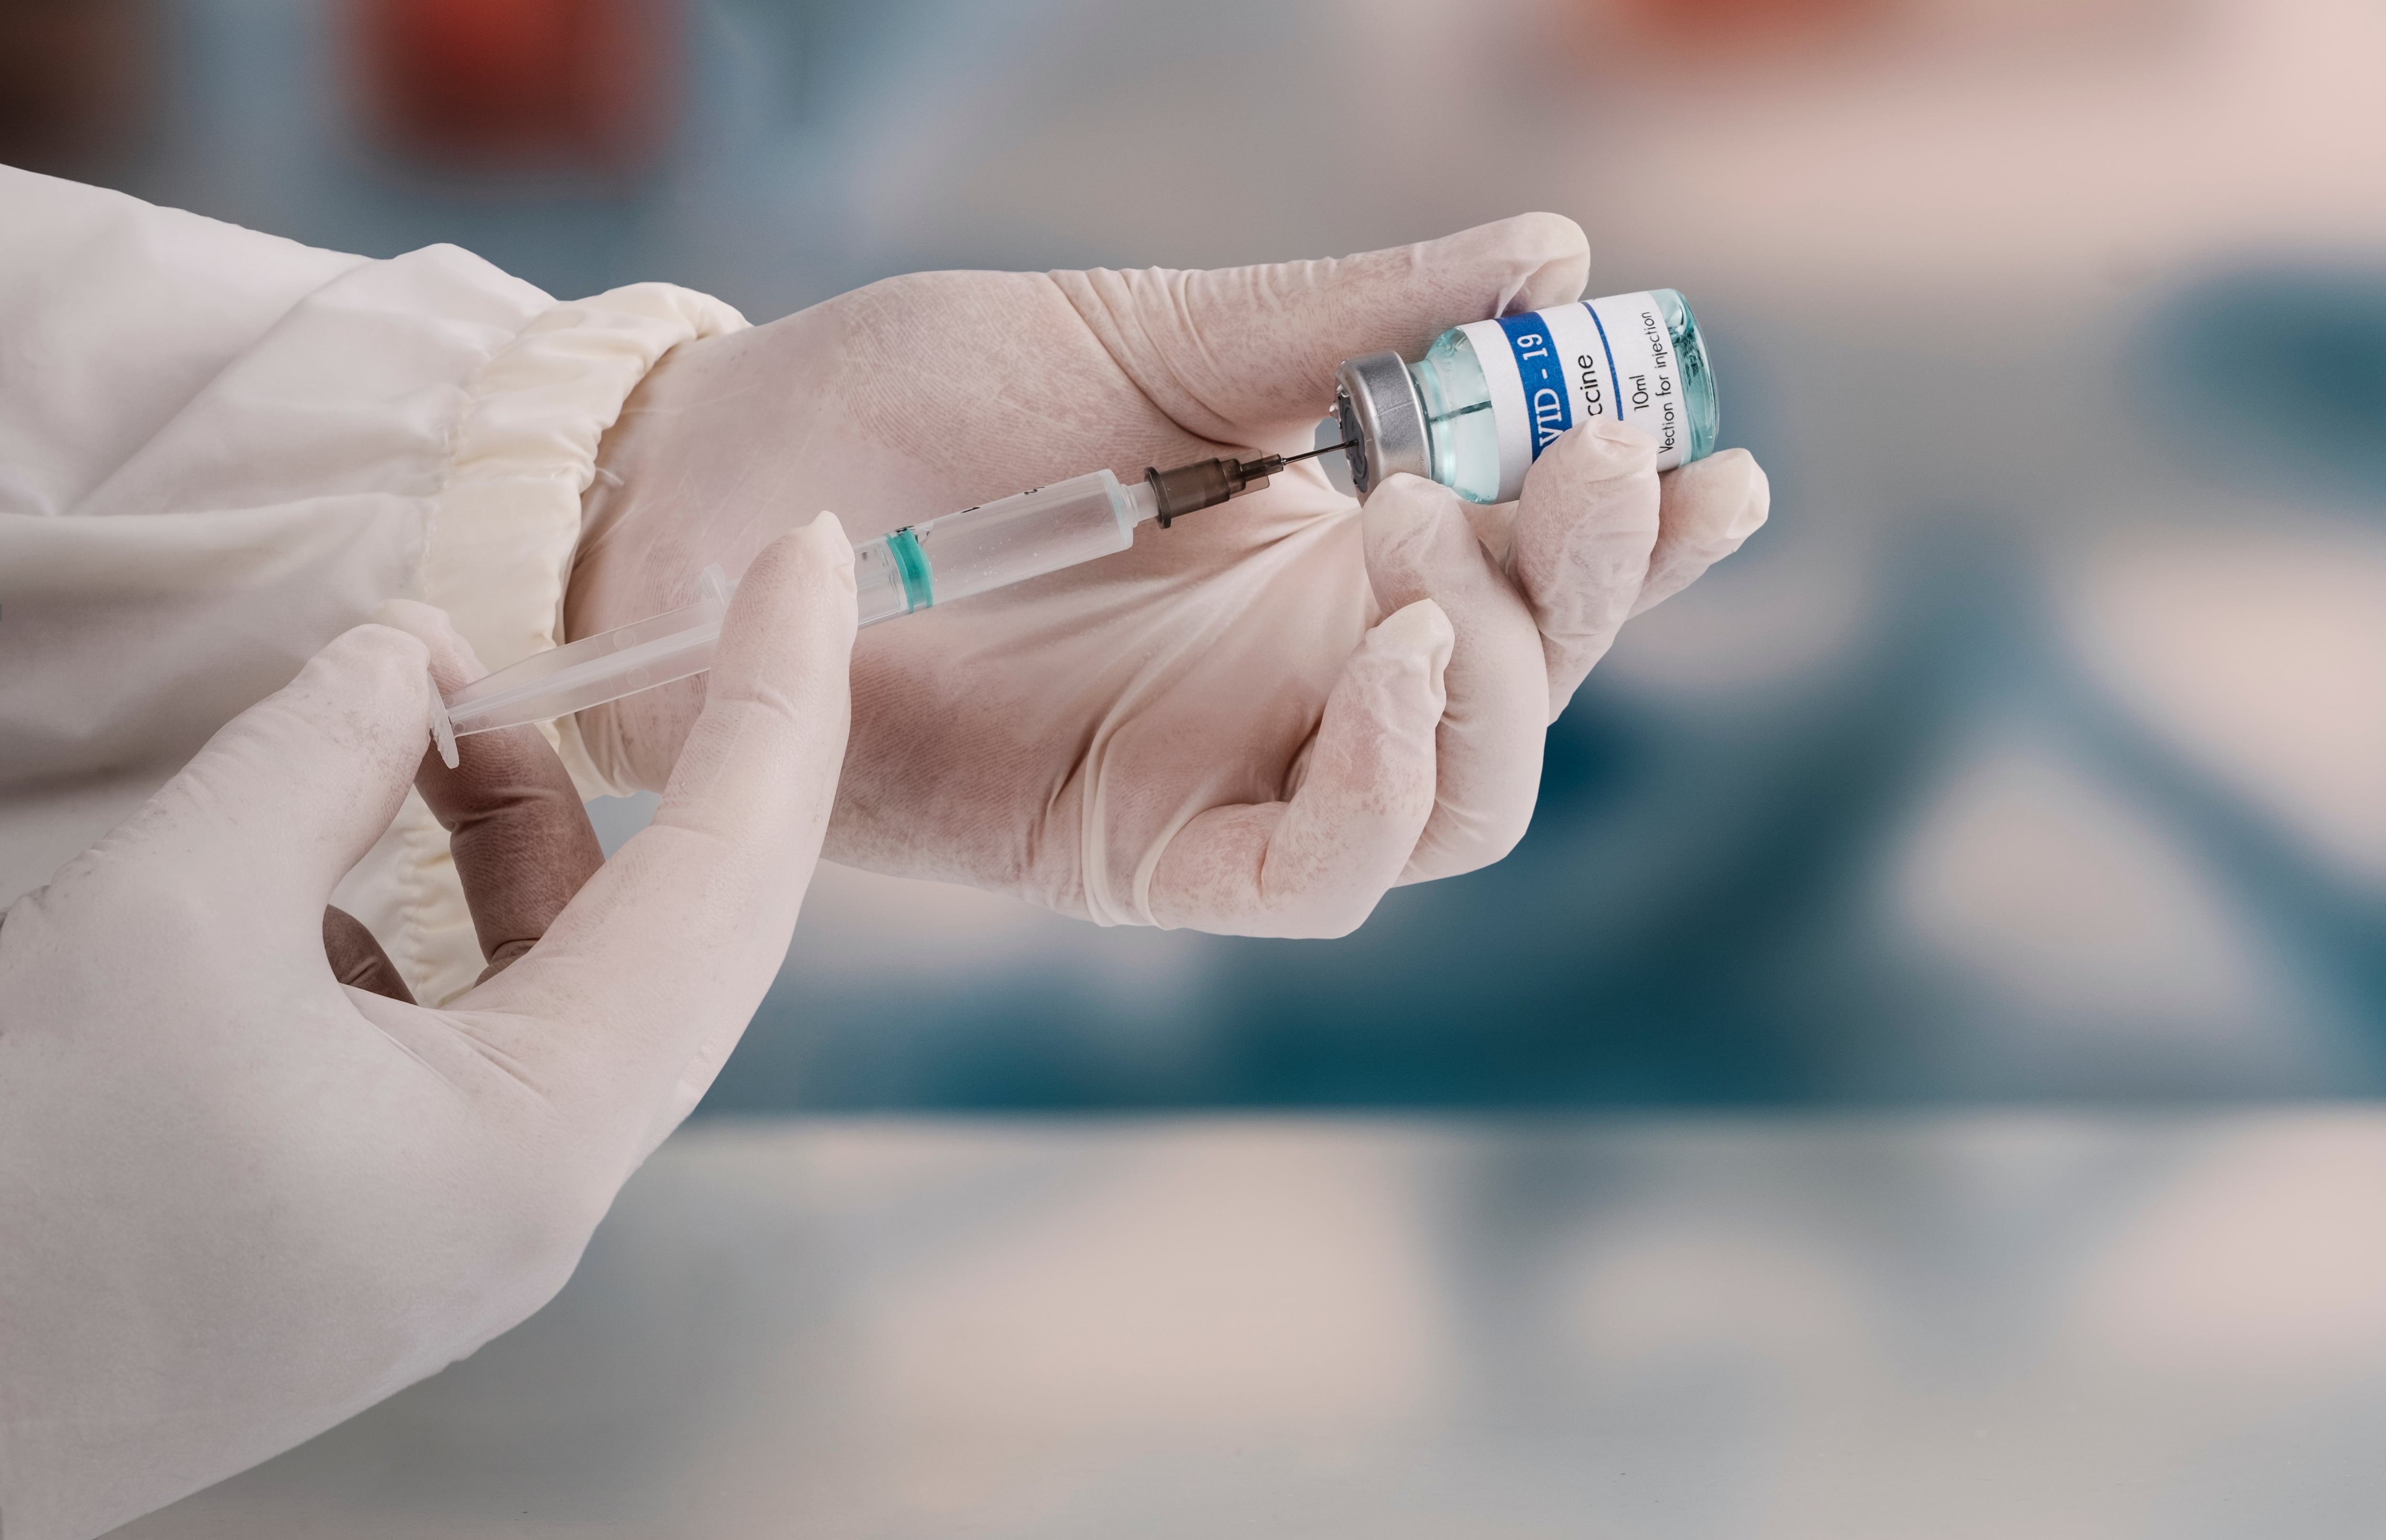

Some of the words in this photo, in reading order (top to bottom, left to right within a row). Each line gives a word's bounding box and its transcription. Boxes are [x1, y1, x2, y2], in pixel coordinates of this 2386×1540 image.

[1517, 333, 1548, 360] 19
[1642, 312, 1668, 368] injection
[1578, 355, 1602, 416] ccine
[1629, 375, 1649, 411] 10ml
[1655, 375, 1671, 396] for
[1534, 388, 1563, 447] VID
[1658, 403, 1675, 454] Vection
